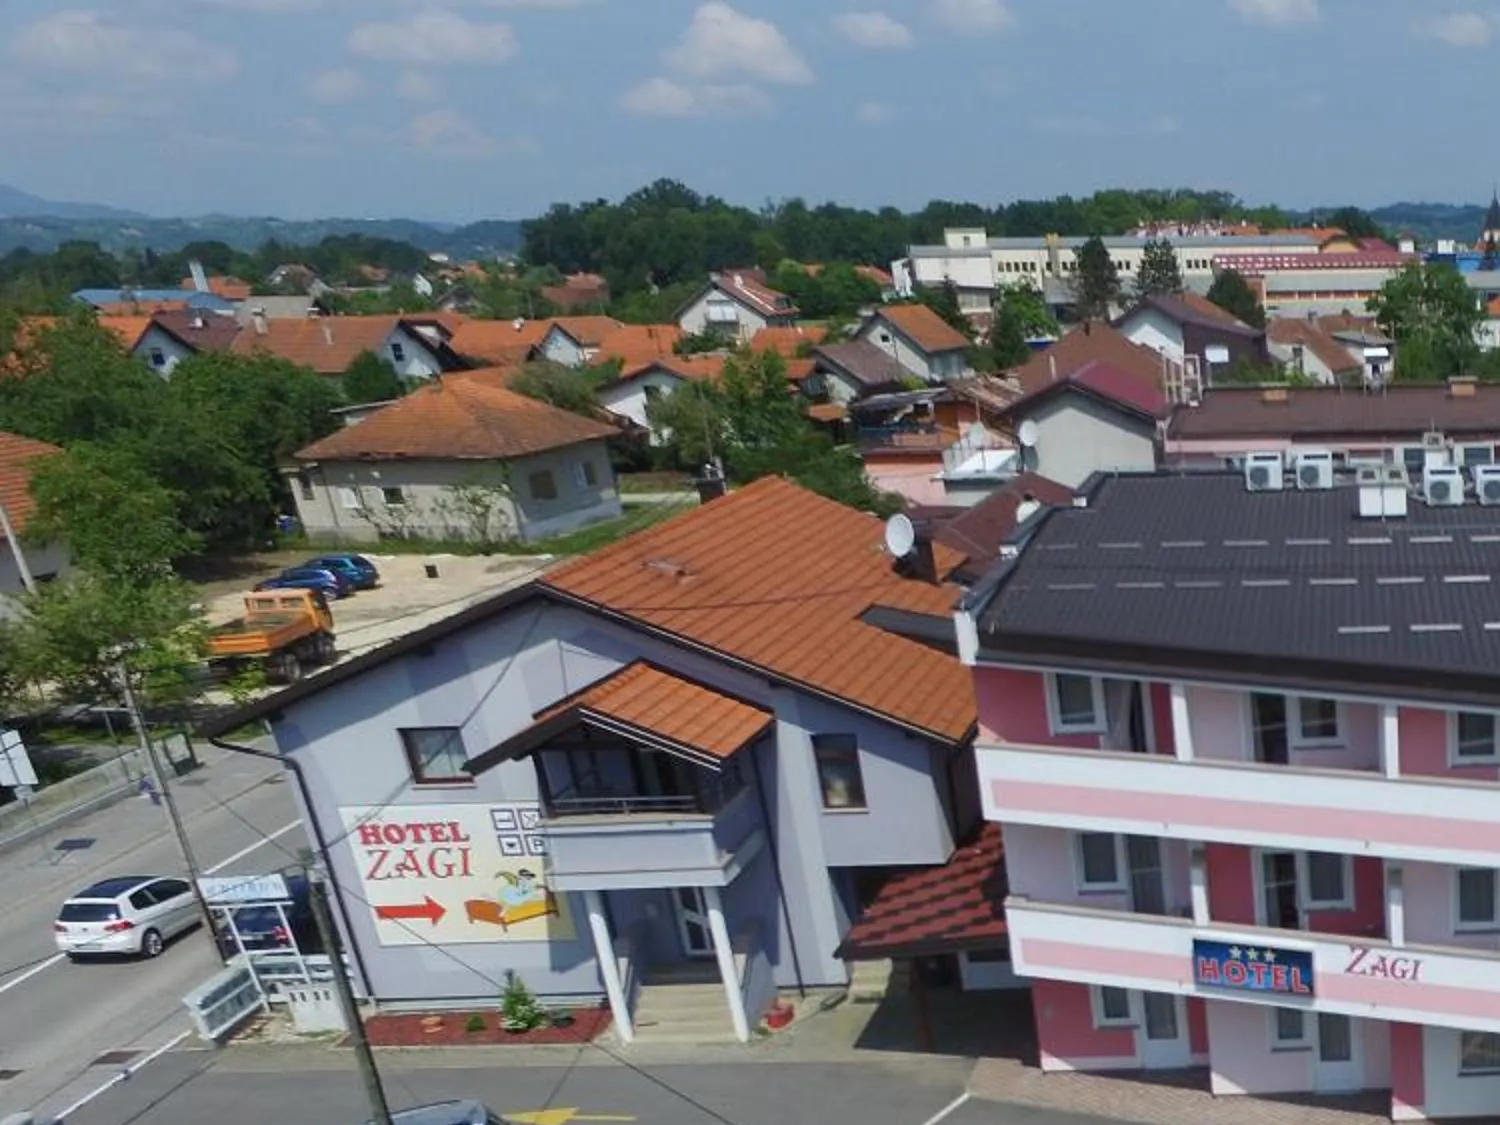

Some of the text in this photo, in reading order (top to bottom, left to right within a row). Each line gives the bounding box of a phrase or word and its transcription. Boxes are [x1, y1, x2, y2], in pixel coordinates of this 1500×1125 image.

[356, 821, 471, 845] HOTEL
[365, 847, 474, 881] ZAGI
[1199, 945, 1424, 994] HOTEL ZAGI
